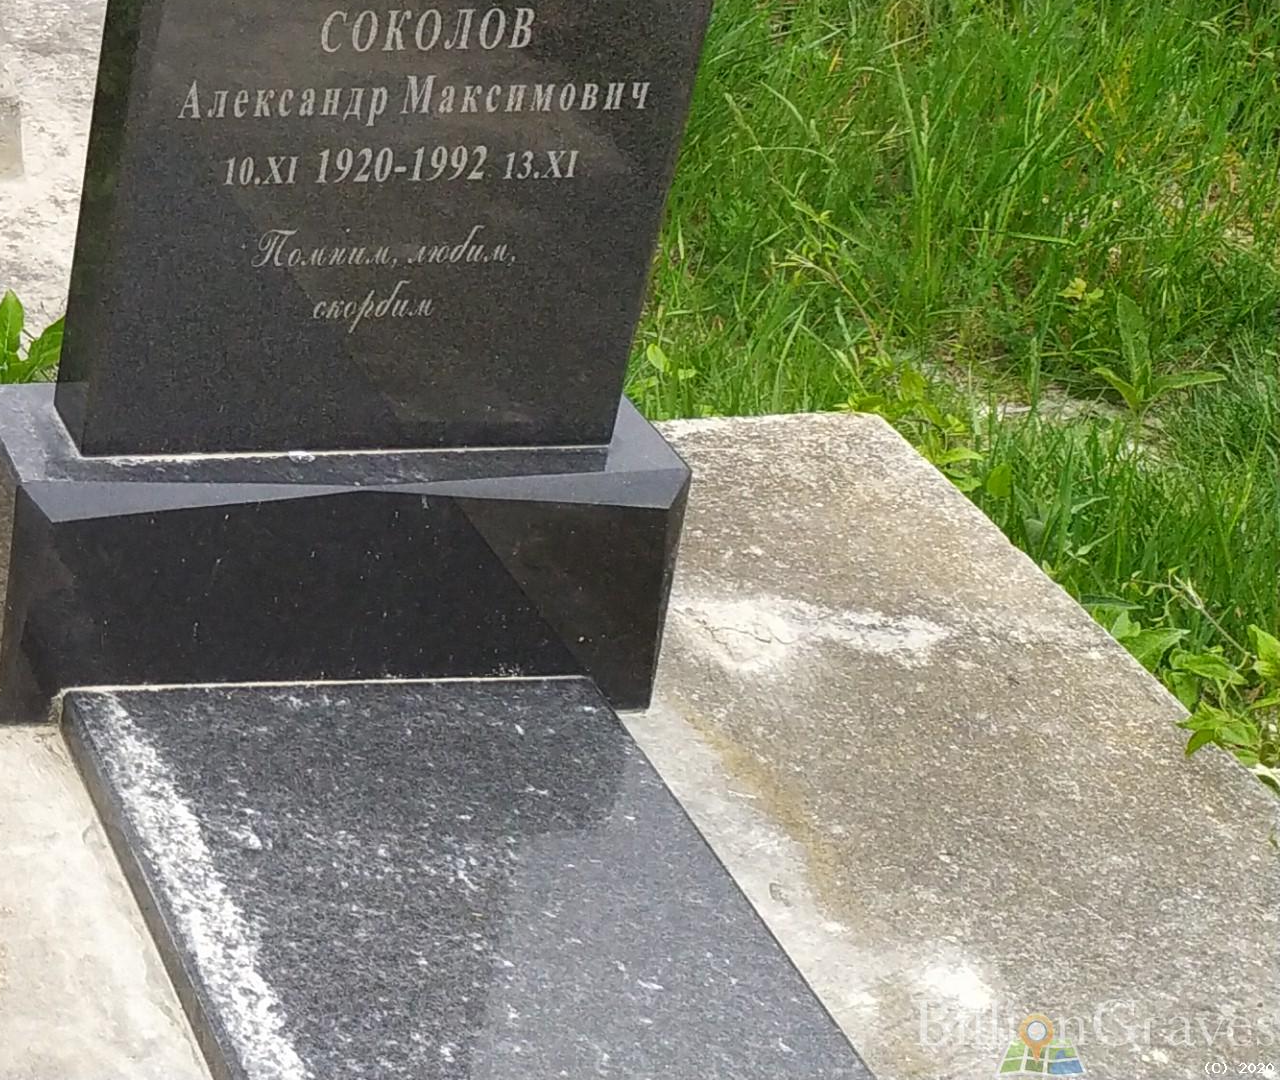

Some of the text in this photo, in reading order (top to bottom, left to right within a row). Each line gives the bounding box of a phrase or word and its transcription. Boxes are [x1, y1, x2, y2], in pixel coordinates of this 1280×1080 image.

[320, 6, 536, 53] СОКОЛОВ
[177, 74, 651, 127] Александр Максимович
[222, 144, 580, 186] 10.XI 1920-1992 13.XI
[251, 224, 517, 268] Помним, любим,
[312, 279, 433, 334] скорбим
